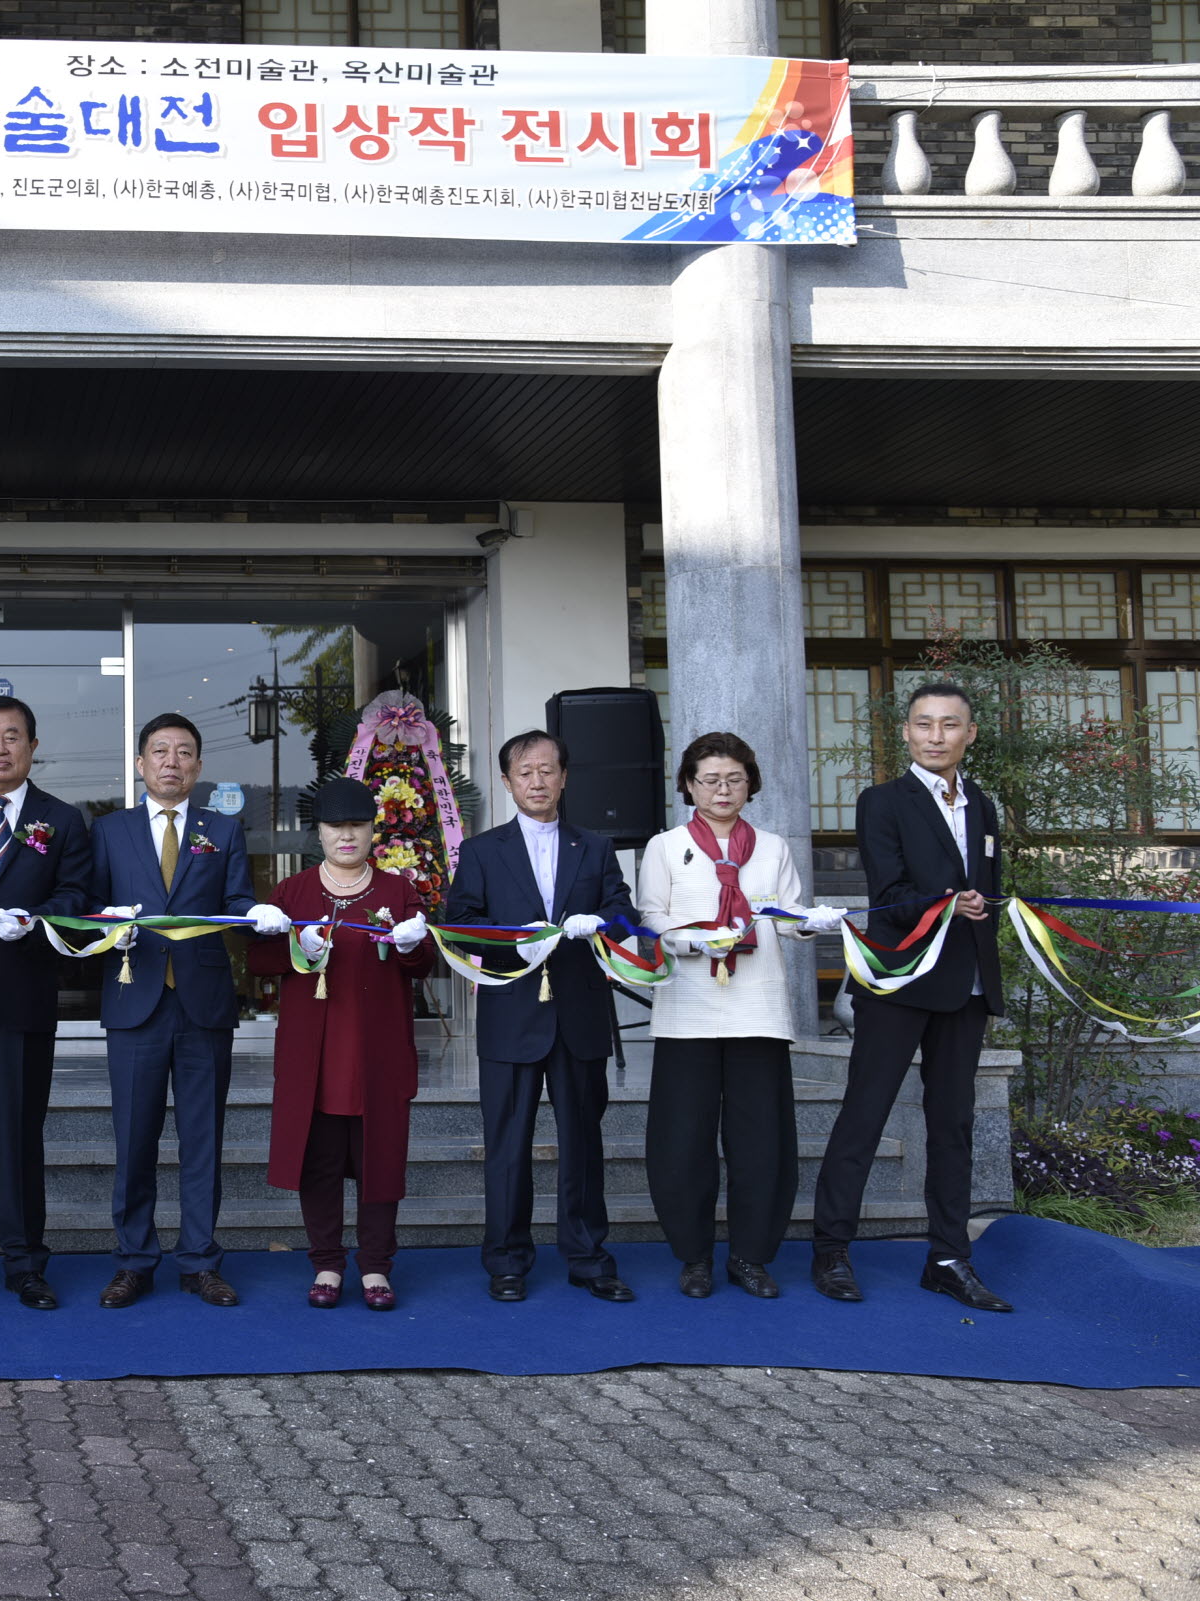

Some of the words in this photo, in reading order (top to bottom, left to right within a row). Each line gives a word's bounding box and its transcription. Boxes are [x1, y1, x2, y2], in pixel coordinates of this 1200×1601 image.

[67, 55, 126, 76] 장소
[161, 58, 327, 82] 소전미술관,
[343, 61, 498, 85] 옥산미술관
[258, 103, 475, 161] 입상작
[502, 110, 711, 168] 전시회
[13, 178, 105, 197] 진도군의회,
[114, 179, 221, 199] (사)한국예총,
[230, 181, 336, 202] (사)한국미협,
[345, 184, 520, 207] (사)한국예총진도지회,
[529, 188, 713, 213] (사)한국미협전남도지회
[434, 776, 458, 828] 대한민국
